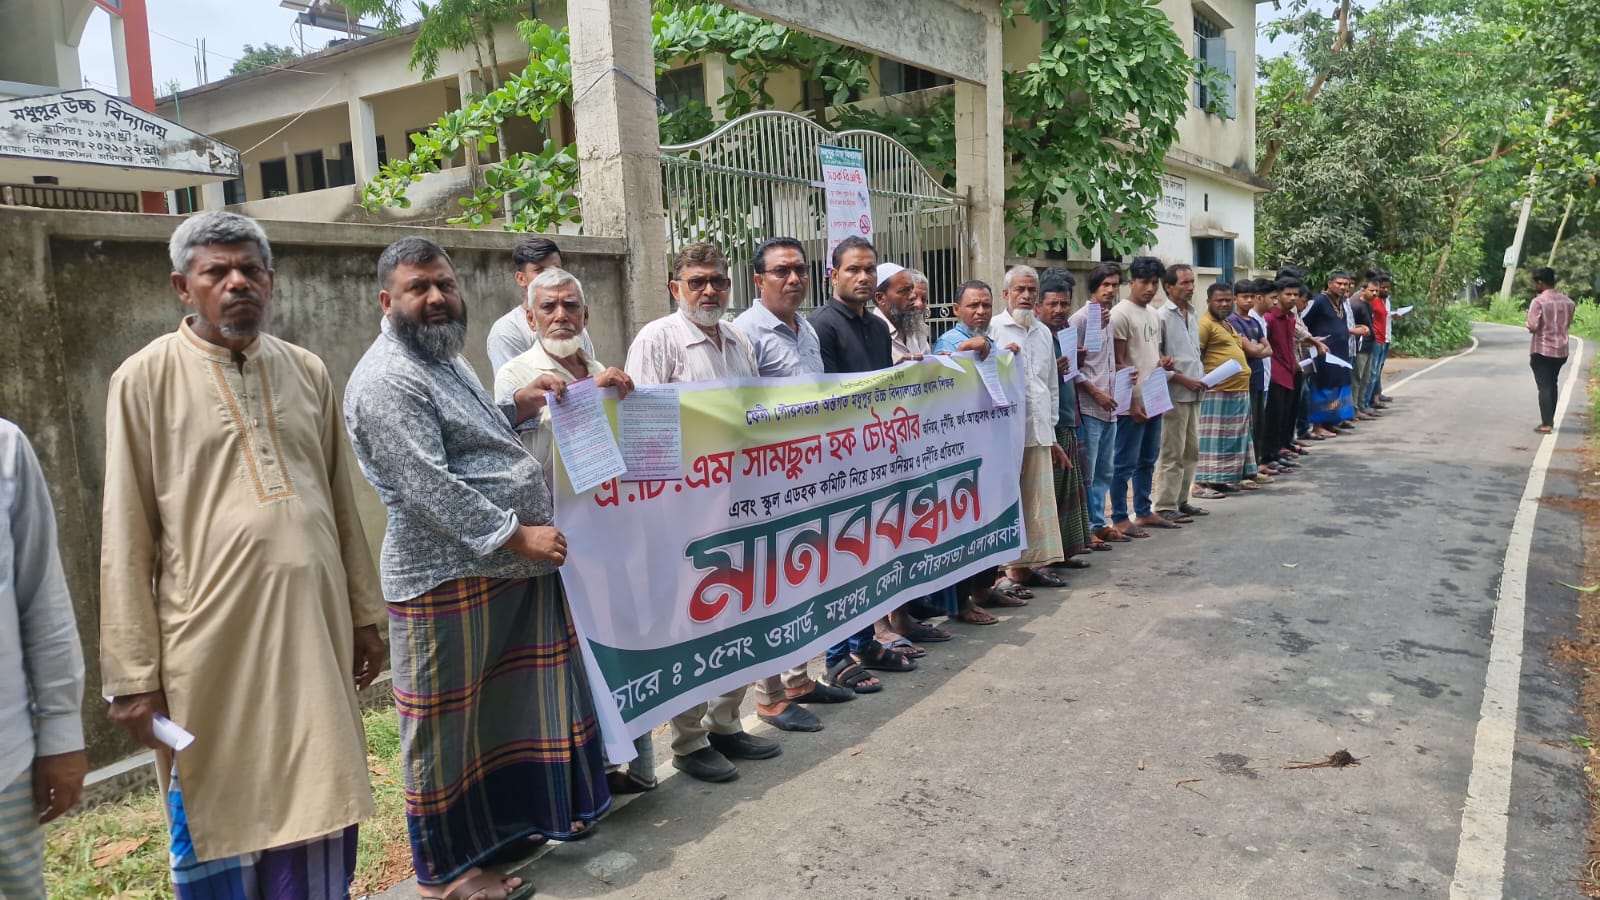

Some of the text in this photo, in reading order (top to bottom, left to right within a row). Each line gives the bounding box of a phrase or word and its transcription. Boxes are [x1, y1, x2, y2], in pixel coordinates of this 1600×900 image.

[9, 95, 168, 140] মধুপুর উচ্চ বিদ্যালয়
[746, 404, 770, 425] ফেনী
[774, 401, 819, 421] পৌরসভার
[851, 391, 872, 409] মধুপুর
[874, 387, 886, 402] উচ্চ
[888, 384, 921, 400] বিদ্যালয়ের
[729, 499, 757, 519] এবং
[761, 492, 780, 516] স্কুল
[784, 482, 817, 504] এডহক
[820, 470, 846, 495] কমিটি
[849, 467, 868, 488] নিয়ে
[870, 464, 887, 482] চরম
[889, 455, 913, 474] অনিয়ম
[915, 459, 920, 468] ও
[940, 441, 965, 460] প্রতিবাদে
[742, 434, 822, 480] সামছুল
[826, 428, 856, 461] হক
[863, 406, 920, 454] চৌধুরীর
[684, 458, 982, 623] মানববন্ধন
[611, 669, 663, 713] চারে
[693, 636, 755, 678] ১৫নং
[764, 602, 819, 648] ওয়ার্ড,
[824, 585, 870, 621] মধুপুর,
[876, 561, 904, 596] ফেনী
[909, 544, 965, 580] পৌরসভা
